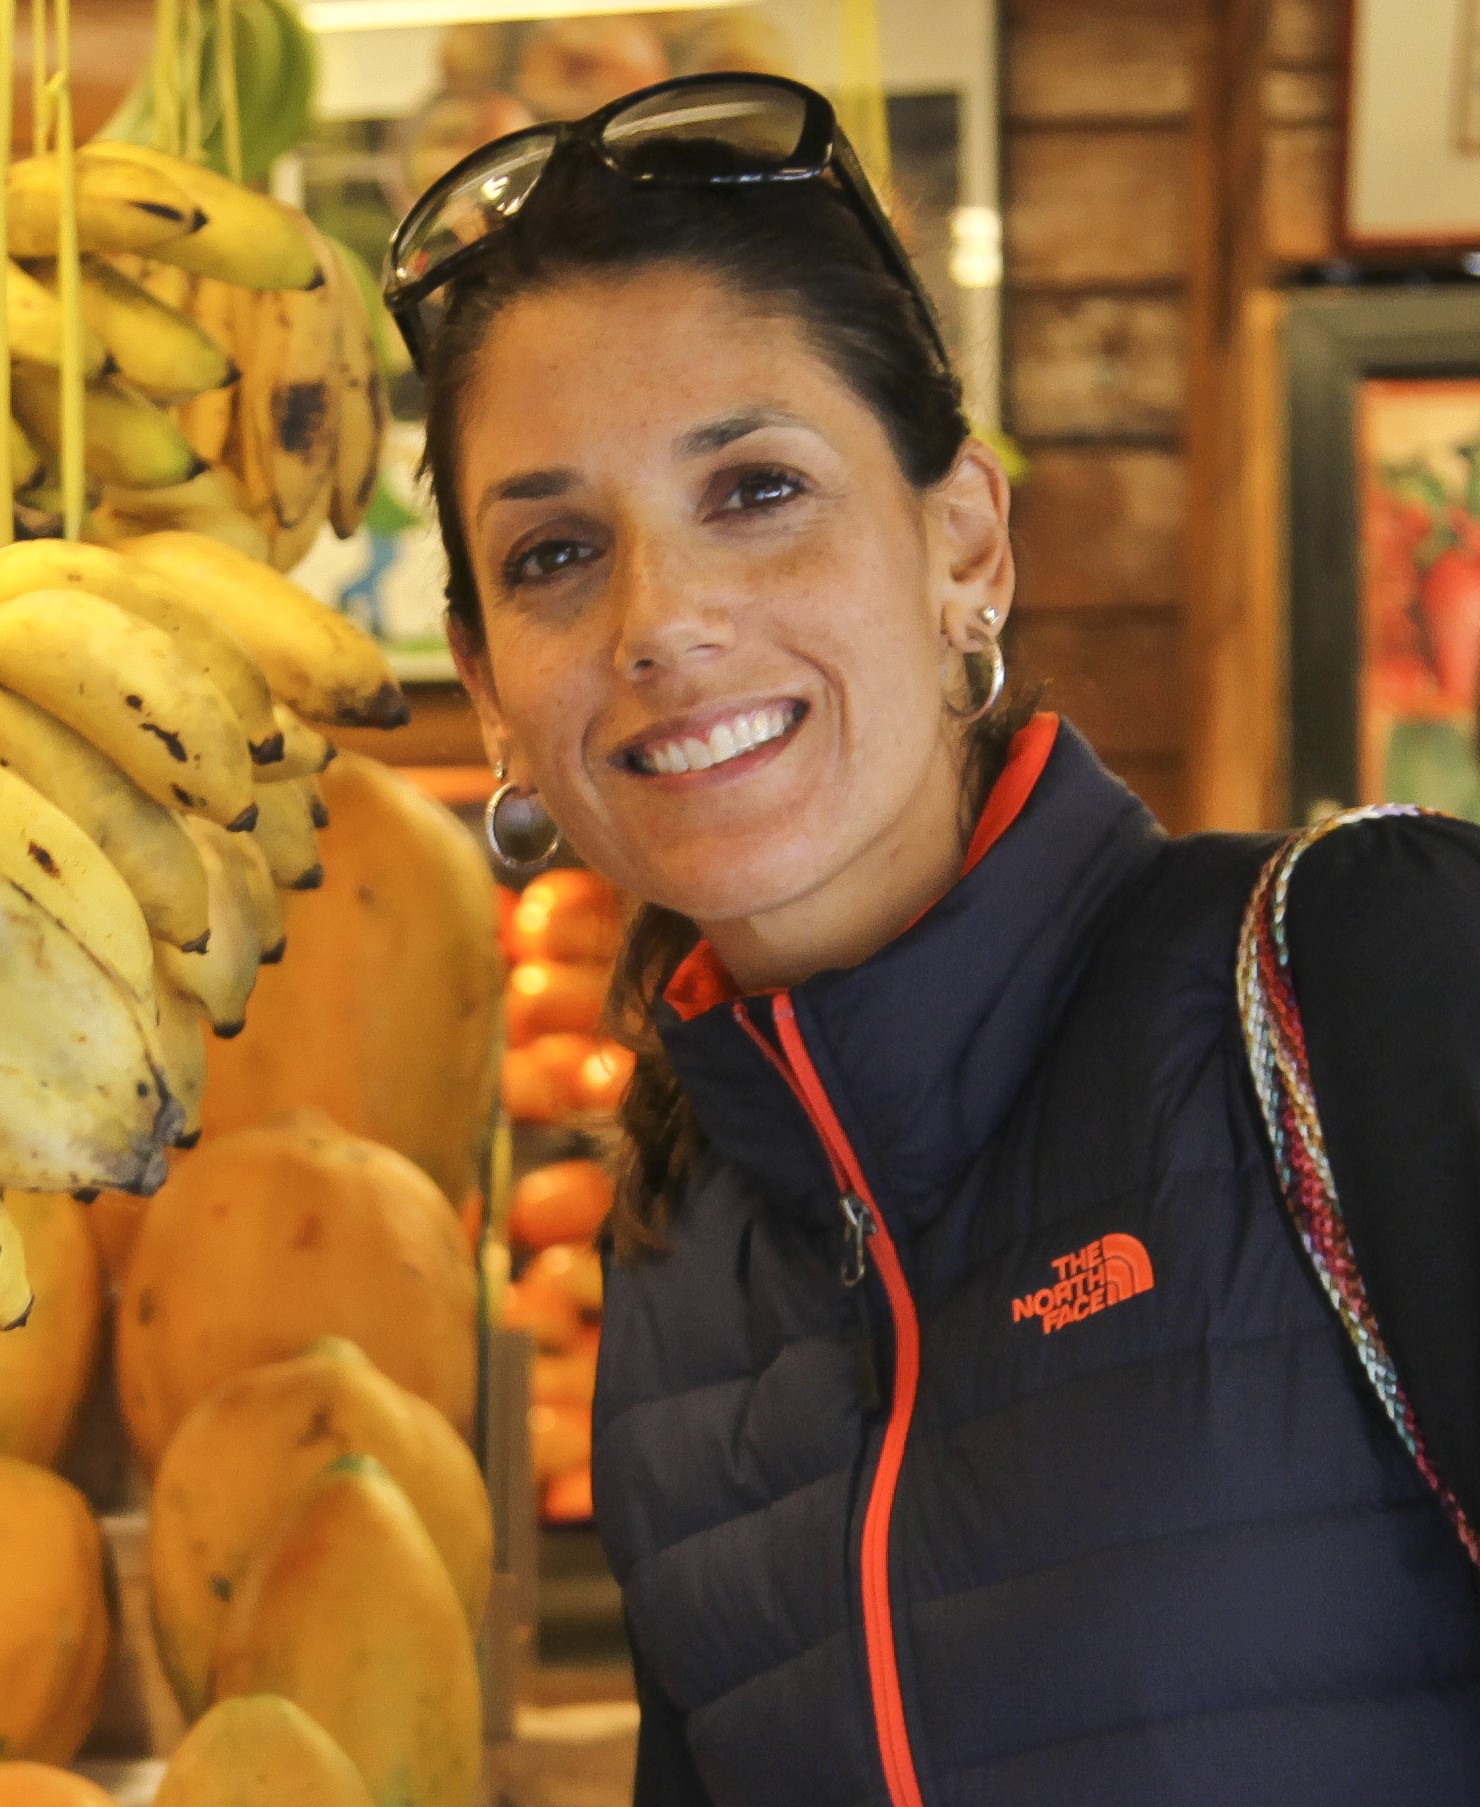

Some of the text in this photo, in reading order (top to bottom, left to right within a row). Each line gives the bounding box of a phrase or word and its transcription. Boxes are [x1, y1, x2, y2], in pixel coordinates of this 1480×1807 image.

[1051, 1239, 1103, 1280] THE
[1011, 1263, 1106, 1323] NORTH
[1042, 1288, 1105, 1335] FACE
